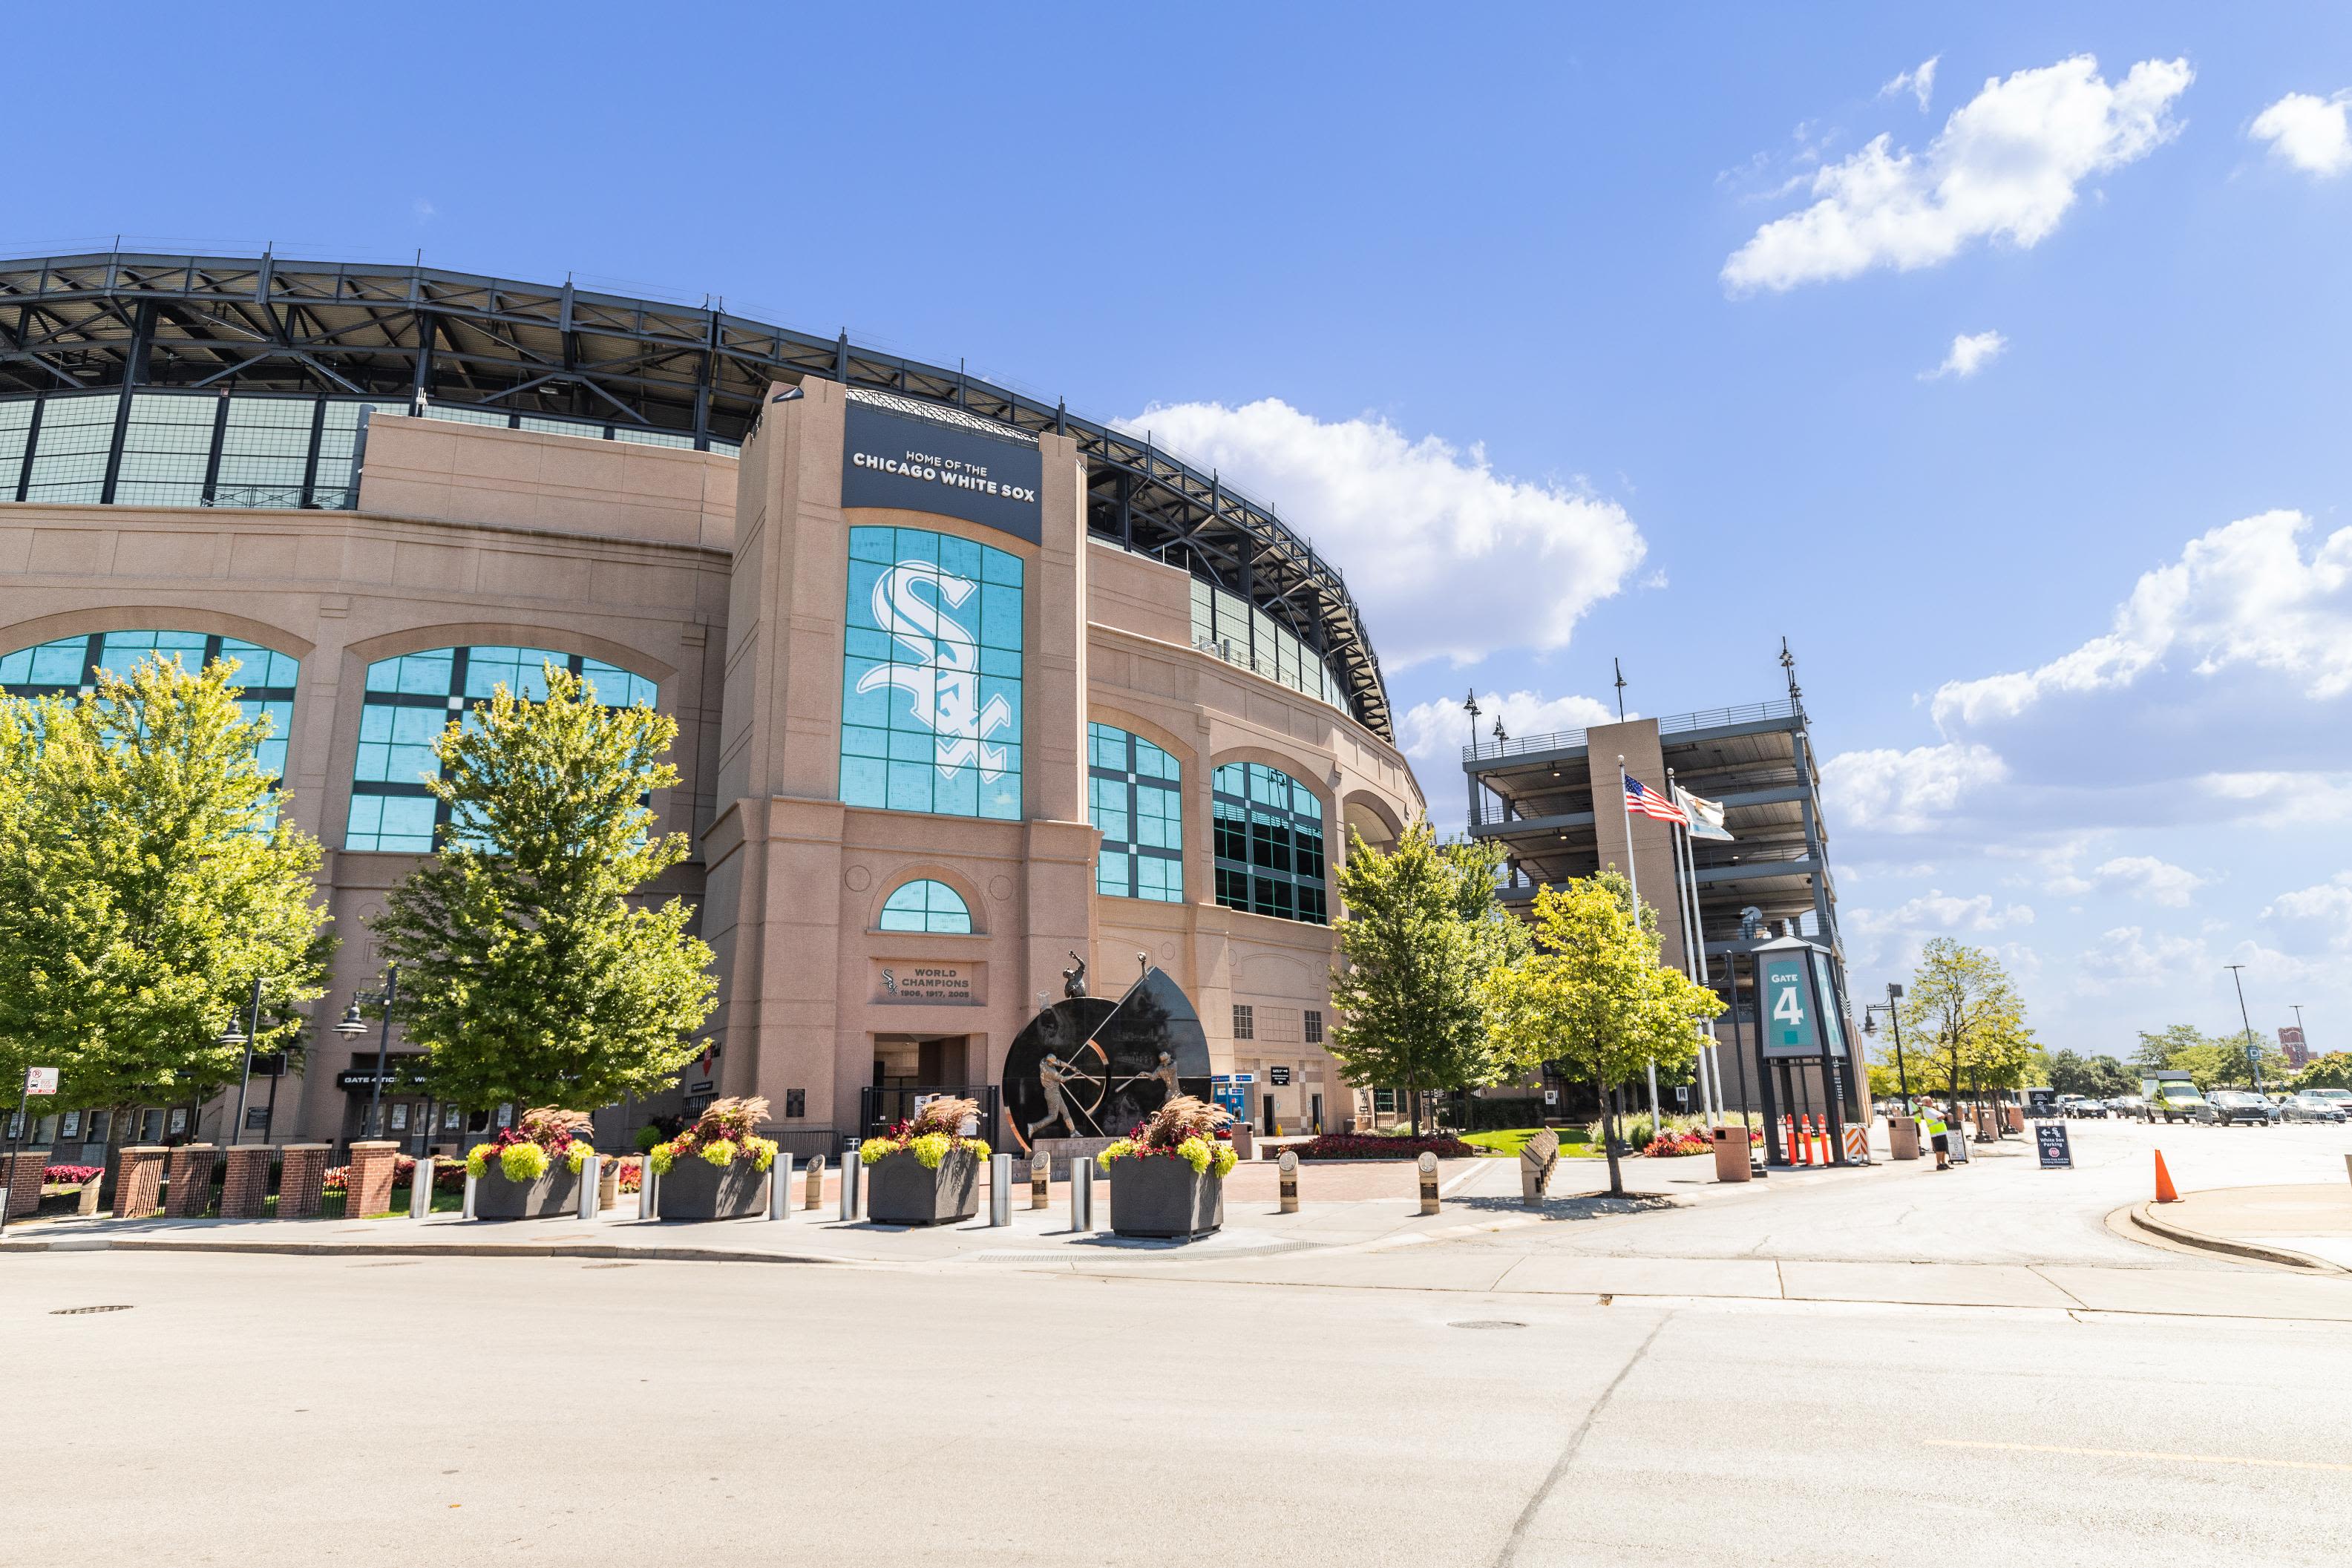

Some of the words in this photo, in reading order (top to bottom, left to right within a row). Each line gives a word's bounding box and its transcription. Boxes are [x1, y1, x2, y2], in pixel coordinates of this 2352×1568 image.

[905, 450, 942, 467] HOME
[944, 459, 961, 470] OF
[964, 463, 988, 477] THE
[853, 453, 936, 481] CHICAGO
[940, 470, 998, 495] WHITE
[1001, 484, 1035, 502] SOX
[915, 968, 957, 977] WORLD
[902, 978, 969, 988] CHAMPIONS
[1771, 974, 1798, 983] GATE
[900, 990, 923, 998] 1906,
[926, 990, 946, 998] 1917,
[1773, 986, 1804, 1026] 4
[2250, 1049, 2258, 1057] D
